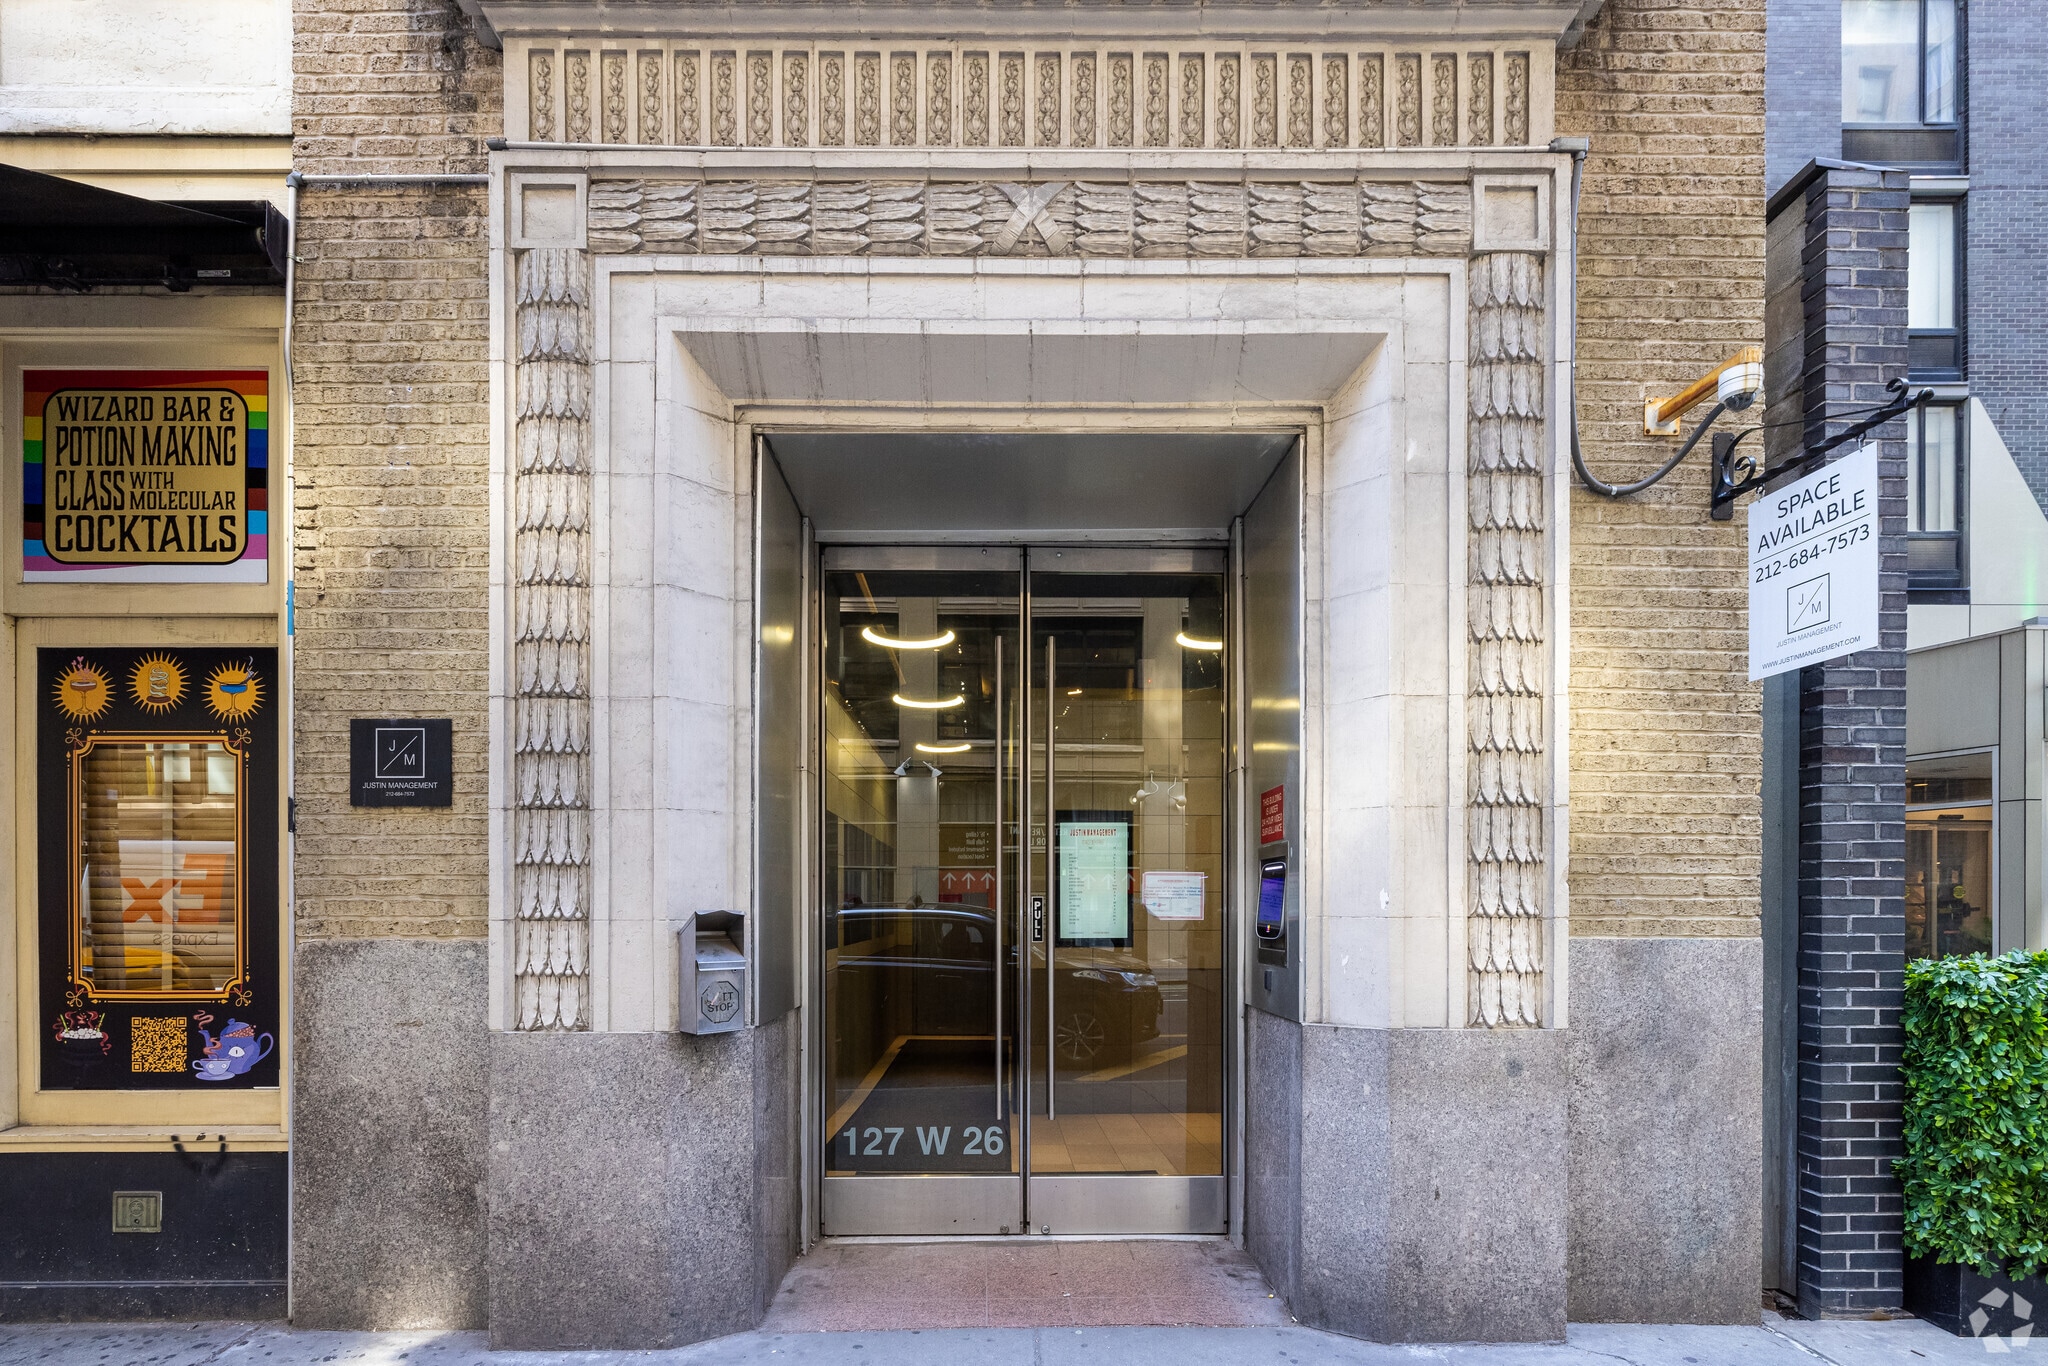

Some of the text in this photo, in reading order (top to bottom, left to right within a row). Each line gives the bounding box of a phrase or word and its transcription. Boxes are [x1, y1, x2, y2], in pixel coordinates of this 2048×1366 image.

[57, 396, 235, 422] WIZARD BAR &
[55, 425, 236, 467] POTION MAKING
[55, 470, 125, 511] CLASS
[130, 471, 175, 490] WITH
[1777, 473, 1841, 519] SPACE
[129, 491, 236, 510] MOLECULAR
[55, 515, 237, 552] COCKTAILS
[1757, 489, 1866, 553] AVAILABLE
[1755, 524, 1870, 583] 212-684-7573
[1762, 635, 1861, 670] WWW.JUSTINMANAGEMENT.COM
[1776, 621, 1842, 649] JUSTIN MANAGEMENT
[1069, 828, 1086, 837] JUSTIN
[1086, 828, 1117, 837] MANAGEMENT
[1033, 901, 1042, 938] PULL
[842, 1126, 1004, 1156] 127 W 26
